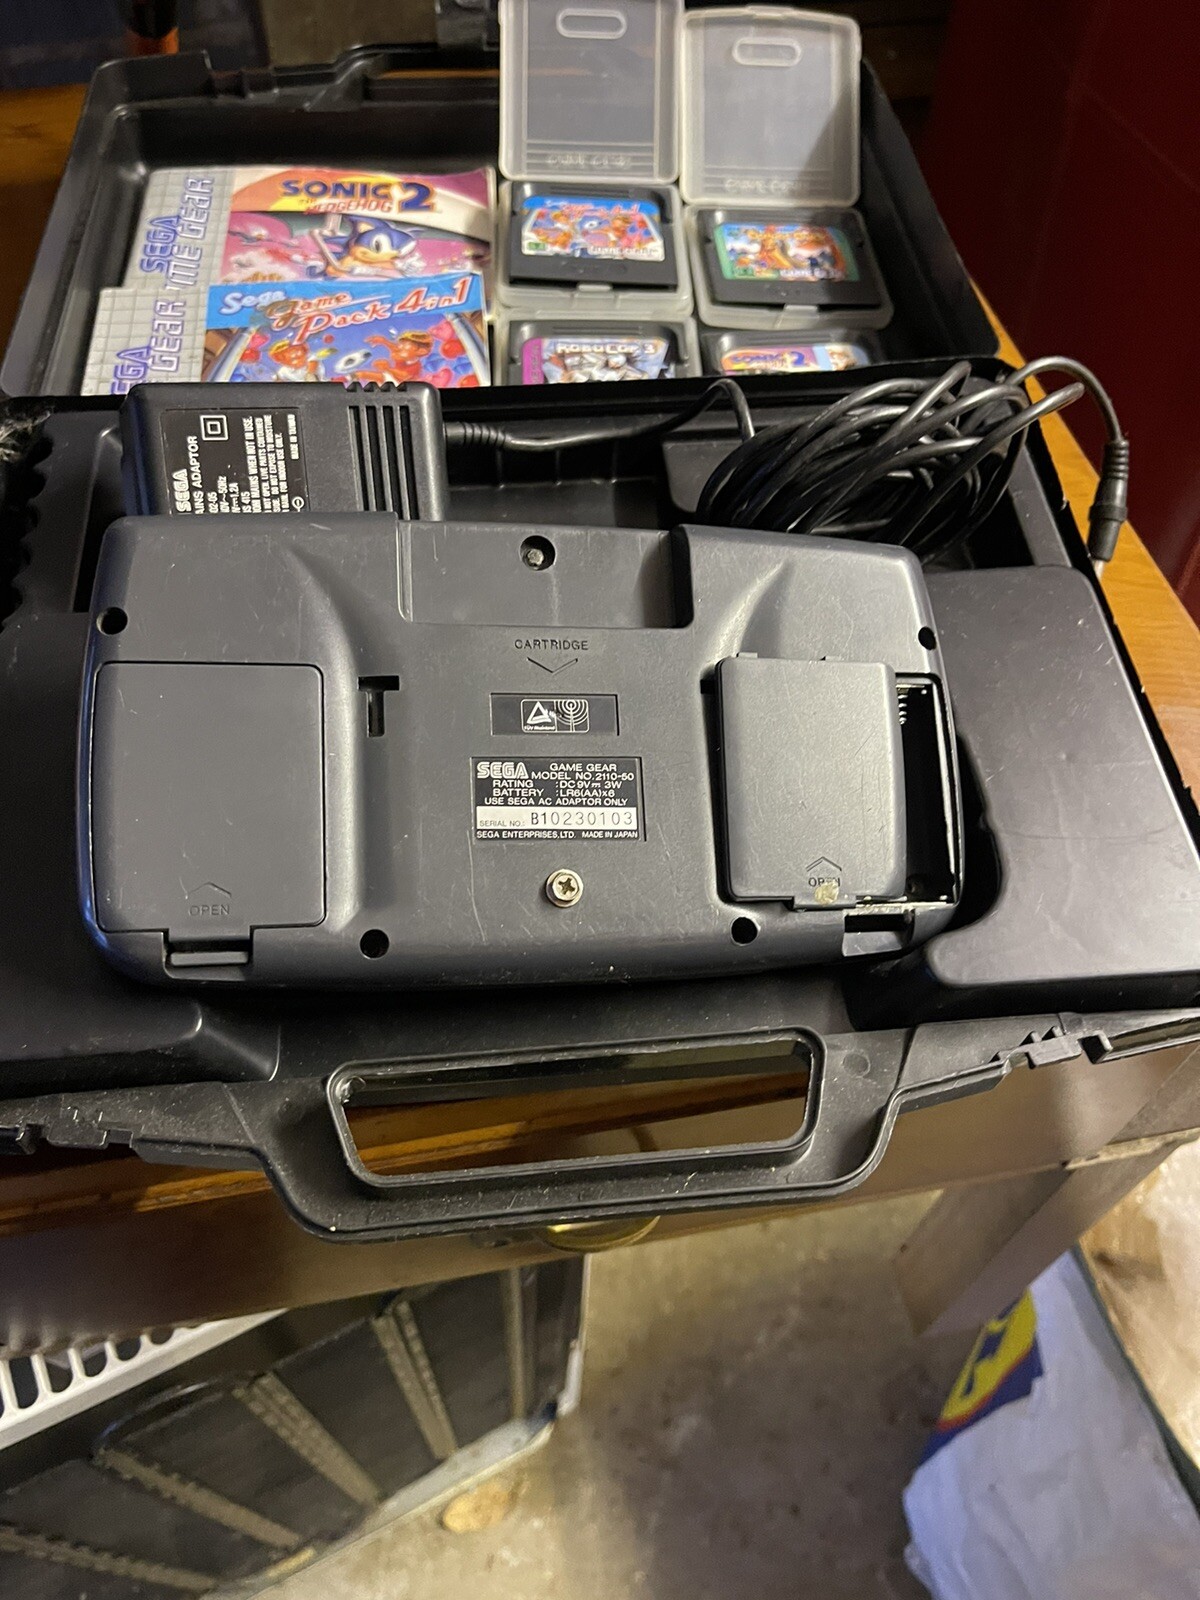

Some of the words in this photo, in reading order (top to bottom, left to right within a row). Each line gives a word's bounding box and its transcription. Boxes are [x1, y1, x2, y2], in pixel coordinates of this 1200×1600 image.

[282, 180, 392, 199] SONIC
[398, 181, 431, 210] 2
[140, 214, 181, 274] SEGA
[219, 290, 286, 316] Sega
[292, 301, 392, 345] Pack
[787, 351, 806, 366] 2
[111, 345, 152, 396] EGA
[245, 441, 256, 455] NOT
[187, 435, 203, 489] ADAPTOR
[247, 455, 258, 475] WHEN
[172, 468, 192, 512] SEGA
[192, 491, 205, 514] AINS
[514, 639, 589, 650] CARTRIDGE
[476, 761, 529, 779] SEGA
[531, 771, 572, 780] MODEL
[550, 763, 583, 772] GAME
[586, 763, 617, 773] GEAR
[492, 779, 534, 788] RATING
[604, 781, 622, 789] 3W
[492, 788, 545, 797] BATTERY
[484, 797, 505, 805] USE
[507, 797, 535, 805] SEGA
[538, 798, 552, 806] AC
[555, 798, 602, 806] ADAPTOR
[603, 798, 628, 806] ONLY
[531, 811, 633, 826] B10230103
[476, 831, 500, 839] SEGA
[582, 831, 604, 839] MADE
[605, 831, 613, 839] IN
[614, 831, 638, 839] JAPAN
[189, 904, 230, 916] OPEN
